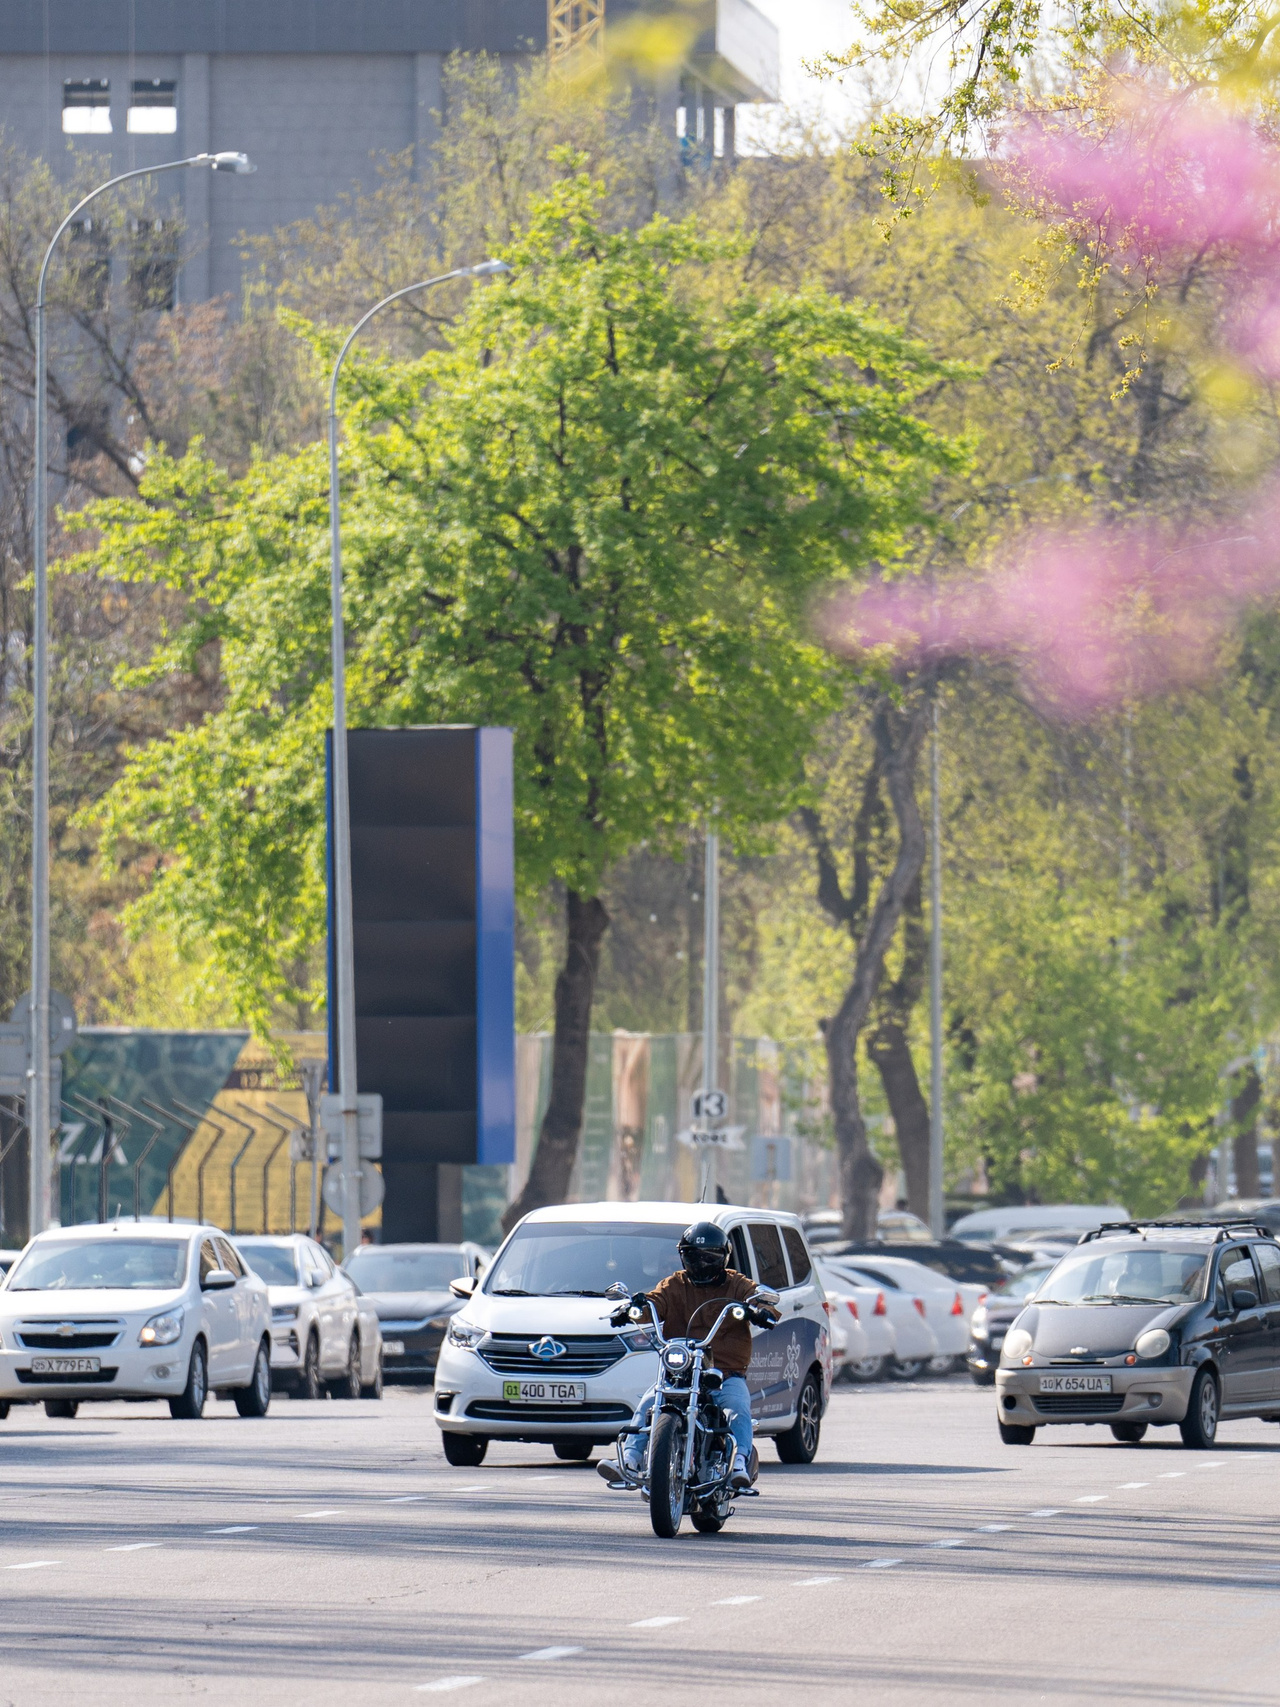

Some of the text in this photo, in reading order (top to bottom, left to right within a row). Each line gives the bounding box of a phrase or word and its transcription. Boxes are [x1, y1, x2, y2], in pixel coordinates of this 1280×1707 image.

[506, 1384, 576, 1398] 01 400 TGA
